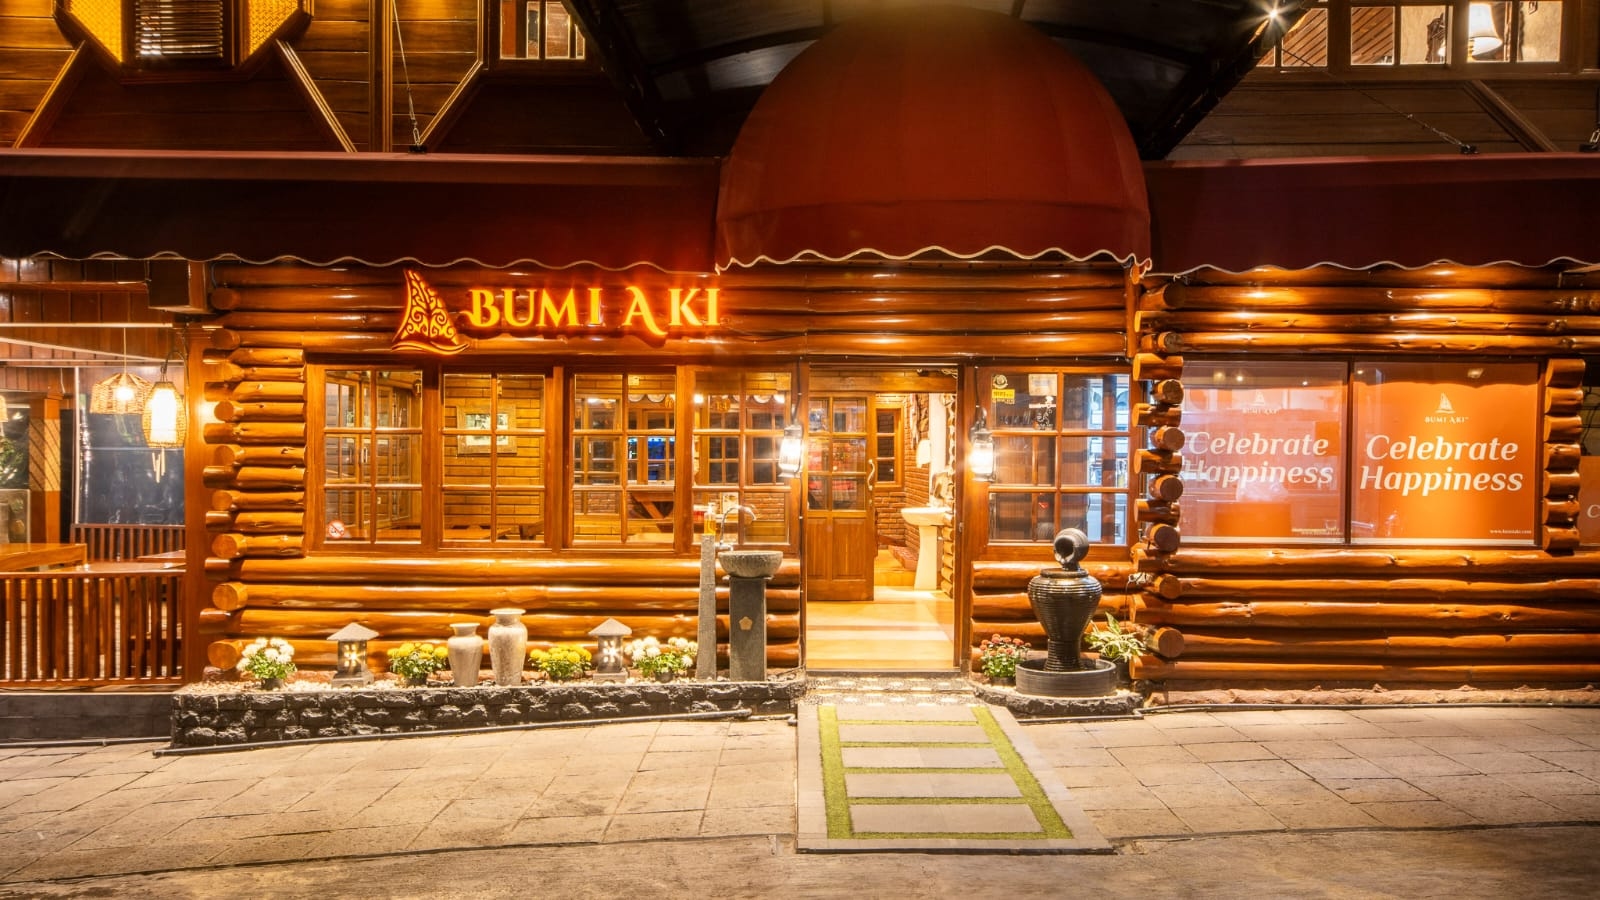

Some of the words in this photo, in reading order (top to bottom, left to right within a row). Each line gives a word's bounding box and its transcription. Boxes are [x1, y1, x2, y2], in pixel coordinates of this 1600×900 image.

[460, 287, 604, 328] BUMI
[624, 285, 721, 337] AKI
[1424, 415, 1447, 424] BUMI
[1188, 431, 1330, 457] Celebrate
[1365, 434, 1519, 462] Celebrate
[1182, 459, 1335, 488] Happiness
[1359, 465, 1524, 497] Happiness
